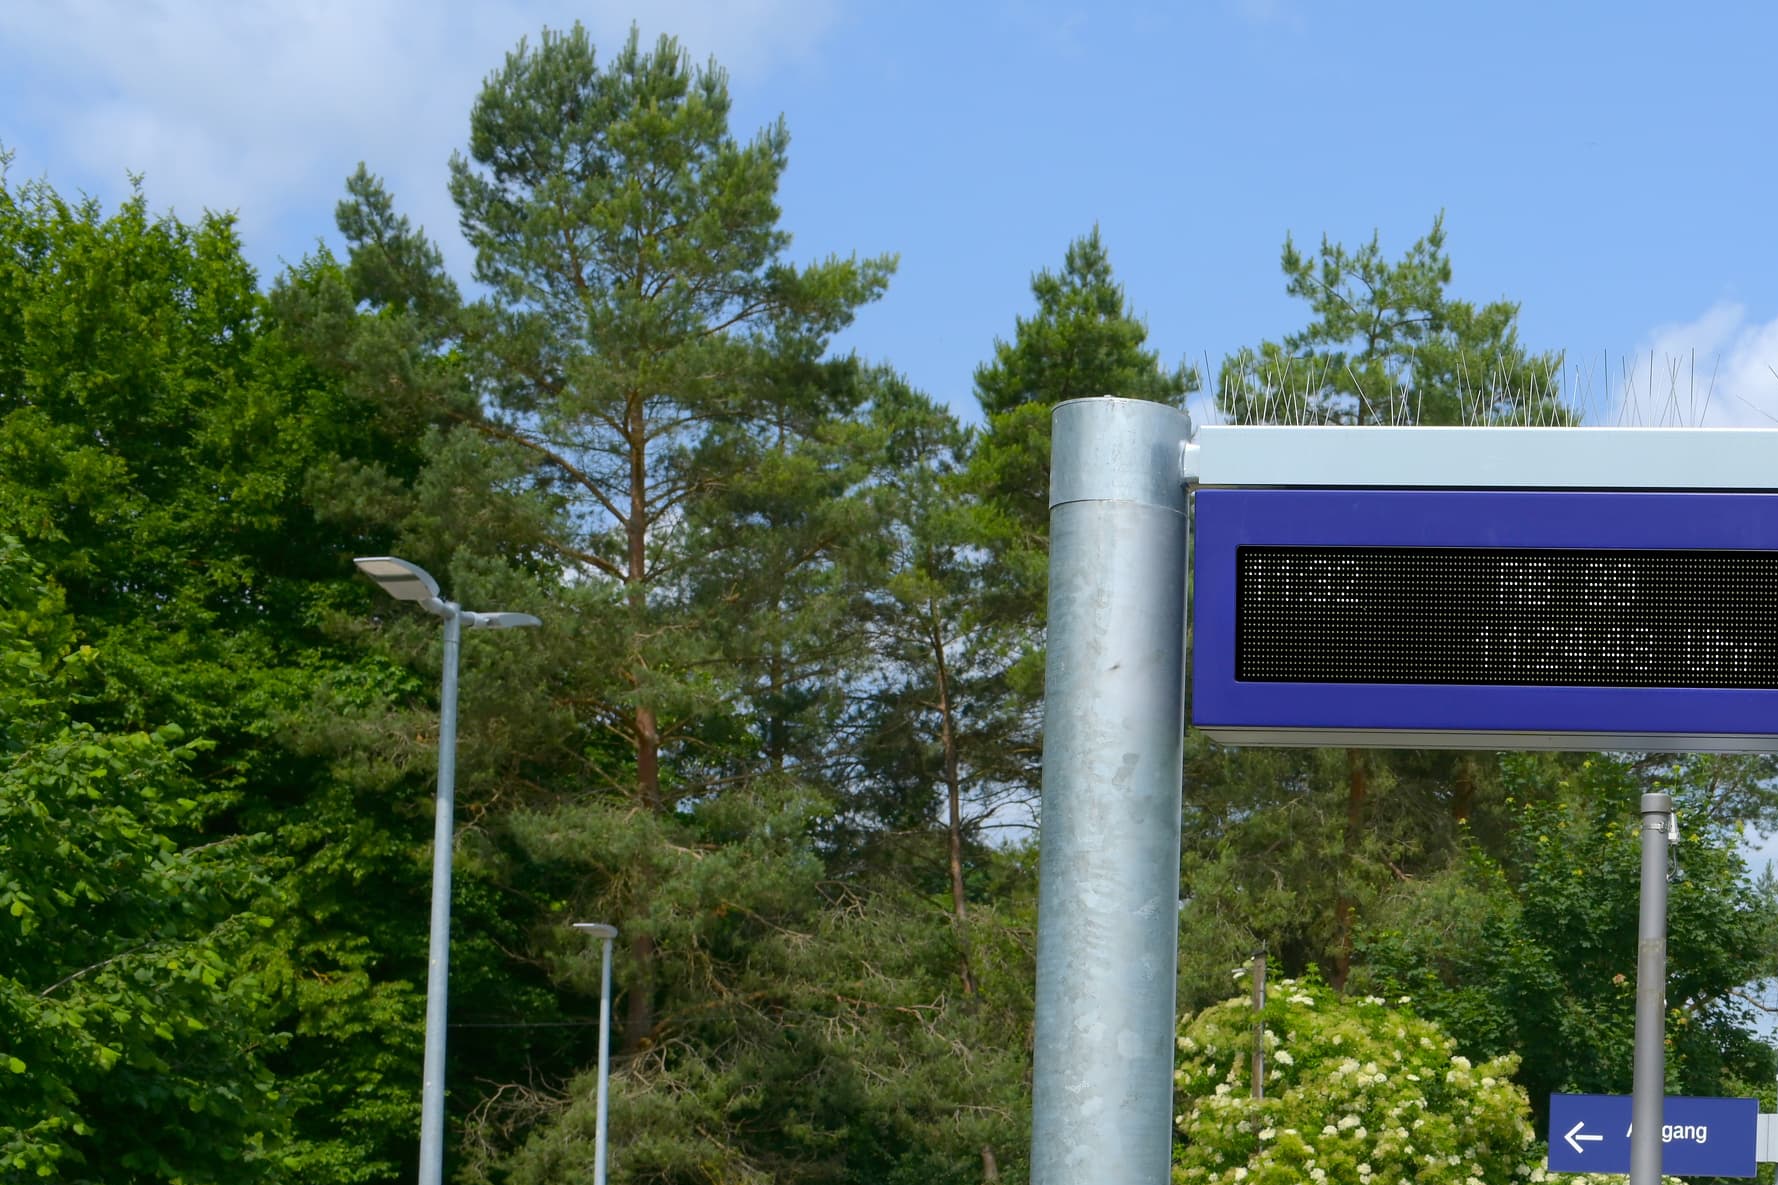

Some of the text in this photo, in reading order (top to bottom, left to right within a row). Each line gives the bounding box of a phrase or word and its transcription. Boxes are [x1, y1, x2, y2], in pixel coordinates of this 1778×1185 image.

[1248, 559, 1360, 603] 11:32
[1500, 562, 1636, 606] RB 89
[1475, 626, 1758, 672] 11:24:48 Uhr
